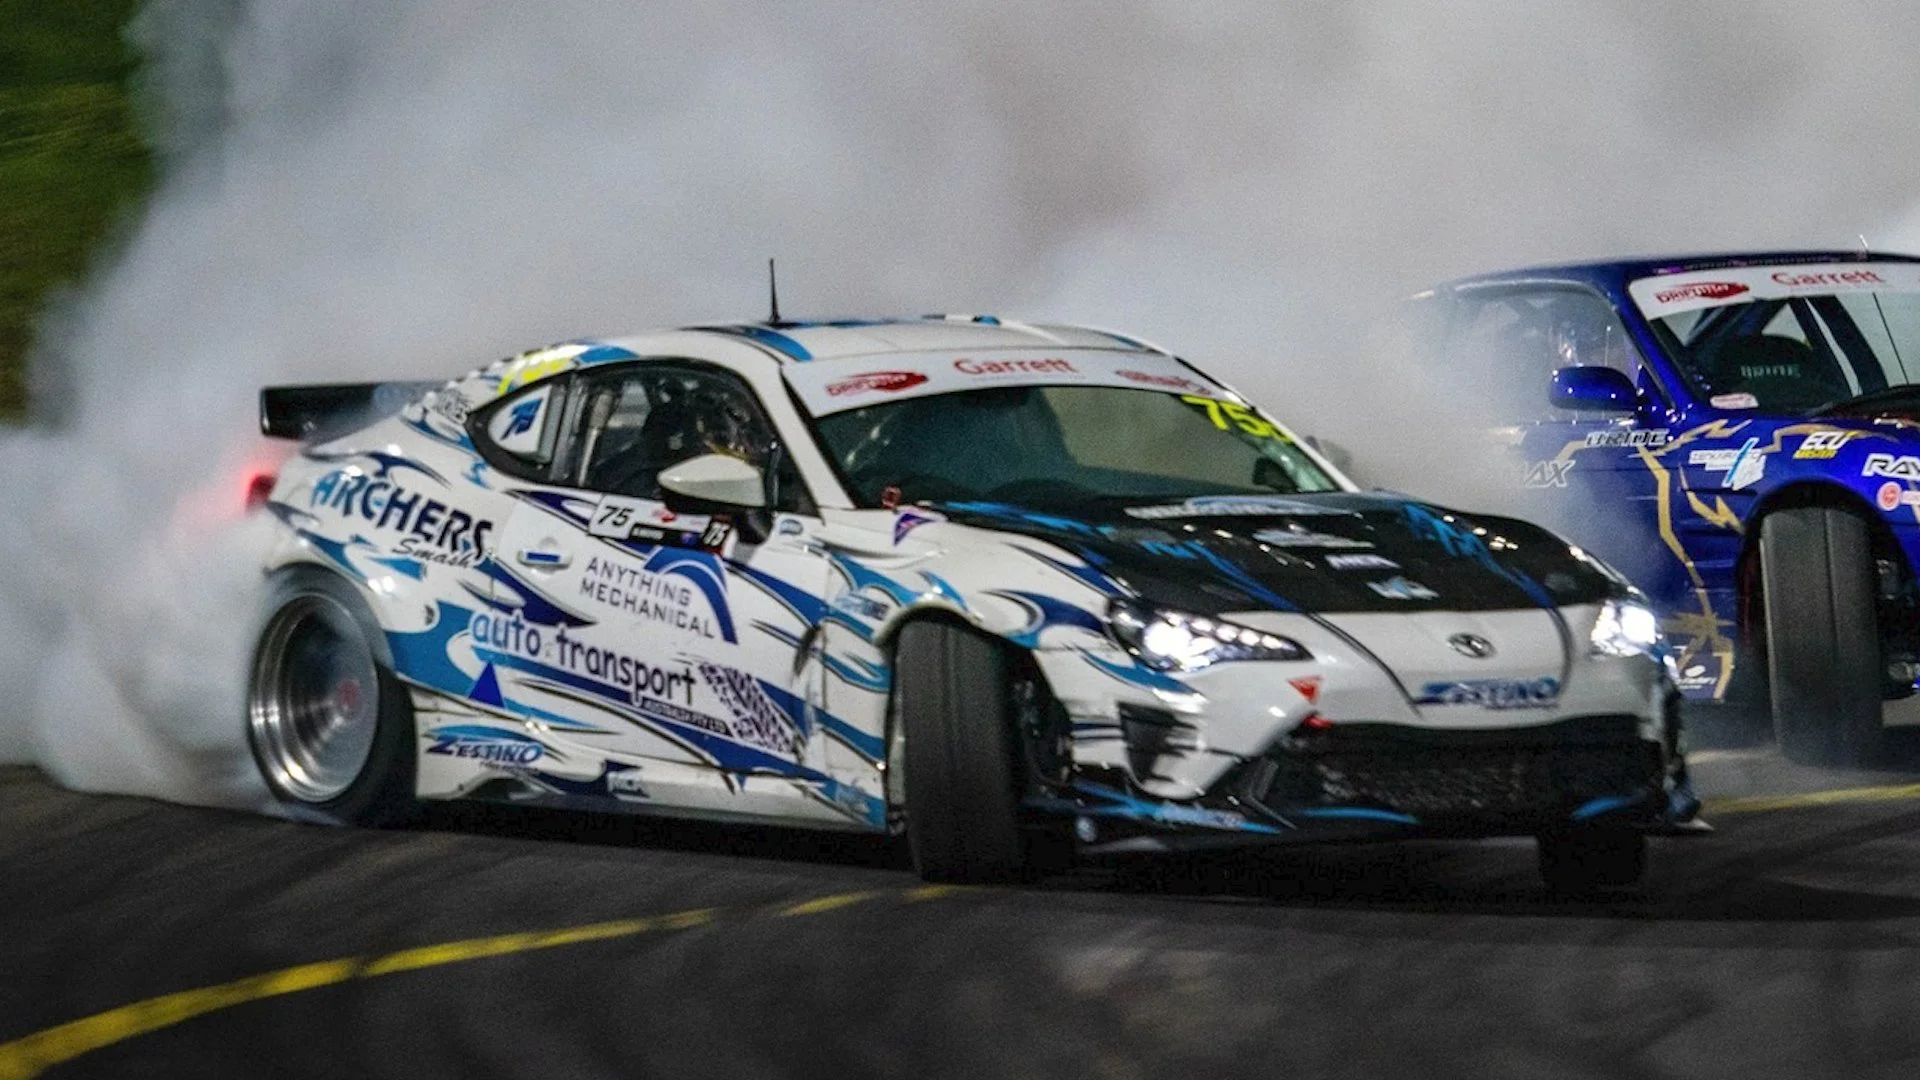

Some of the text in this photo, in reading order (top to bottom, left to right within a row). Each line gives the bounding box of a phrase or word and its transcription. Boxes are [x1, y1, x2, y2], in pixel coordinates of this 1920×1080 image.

[1771, 269, 1886, 288] Garrett
[953, 357, 1080, 377] Garrett
[1799, 431, 1853, 450] ECU
[310, 469, 494, 560] ARCHERS
[598, 505, 635, 528] 75
[393, 538, 475, 569] Smash
[586, 557, 692, 607] ANYTHING
[580, 577, 715, 639] MECHANICAL
[471, 612, 697, 706] auto transport
[426, 734, 544, 764] ZESTINO
